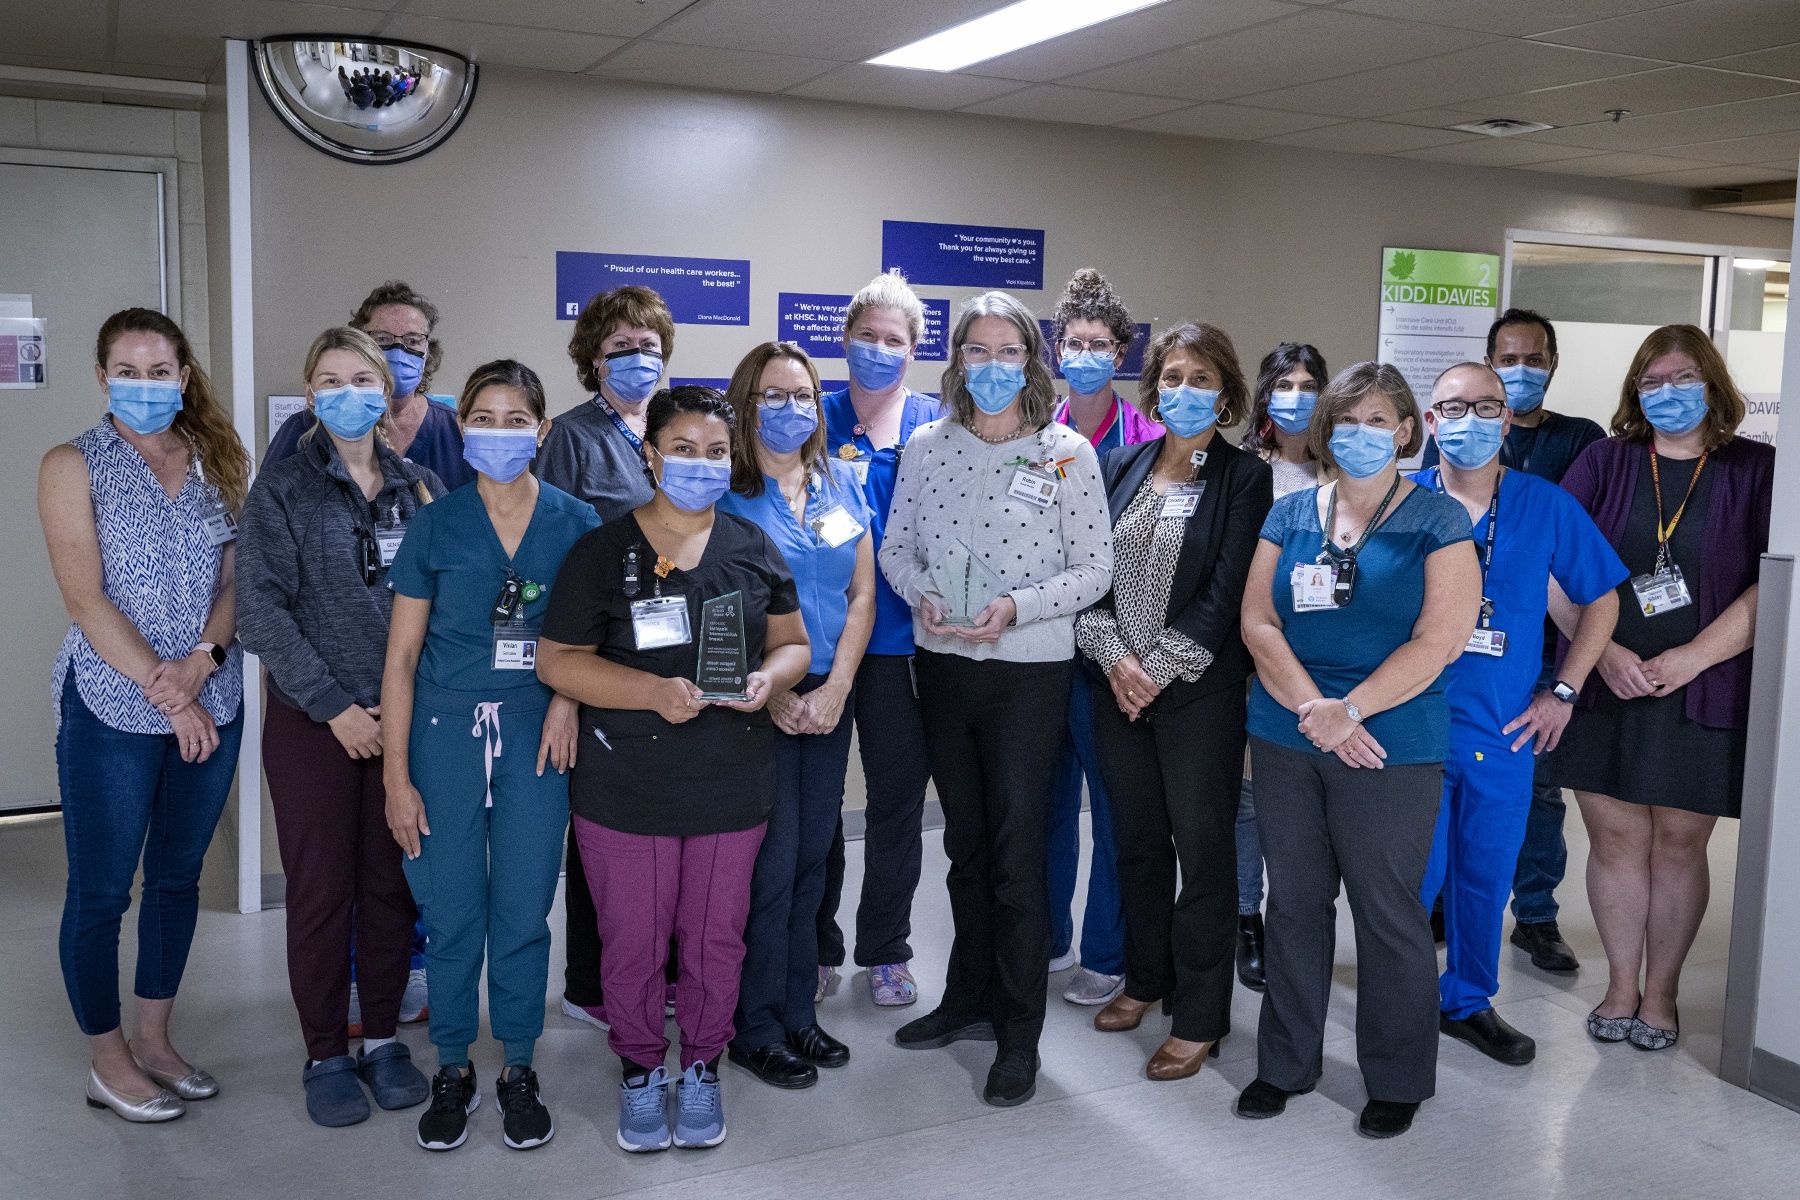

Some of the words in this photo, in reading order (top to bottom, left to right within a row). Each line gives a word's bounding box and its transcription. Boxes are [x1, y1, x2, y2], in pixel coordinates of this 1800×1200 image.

[976, 237, 1010, 246] community
[939, 243, 960, 251] Thank
[984, 246, 1006, 254] always
[1008, 248, 1027, 256] giving
[610, 264, 634, 272] Proud
[704, 270, 740, 278] workers...
[1478, 263, 1490, 288] 2
[1383, 285, 1427, 302] KIDD
[1437, 288, 1490, 306] DAVIES
[1748, 402, 1780, 414] DAVIE
